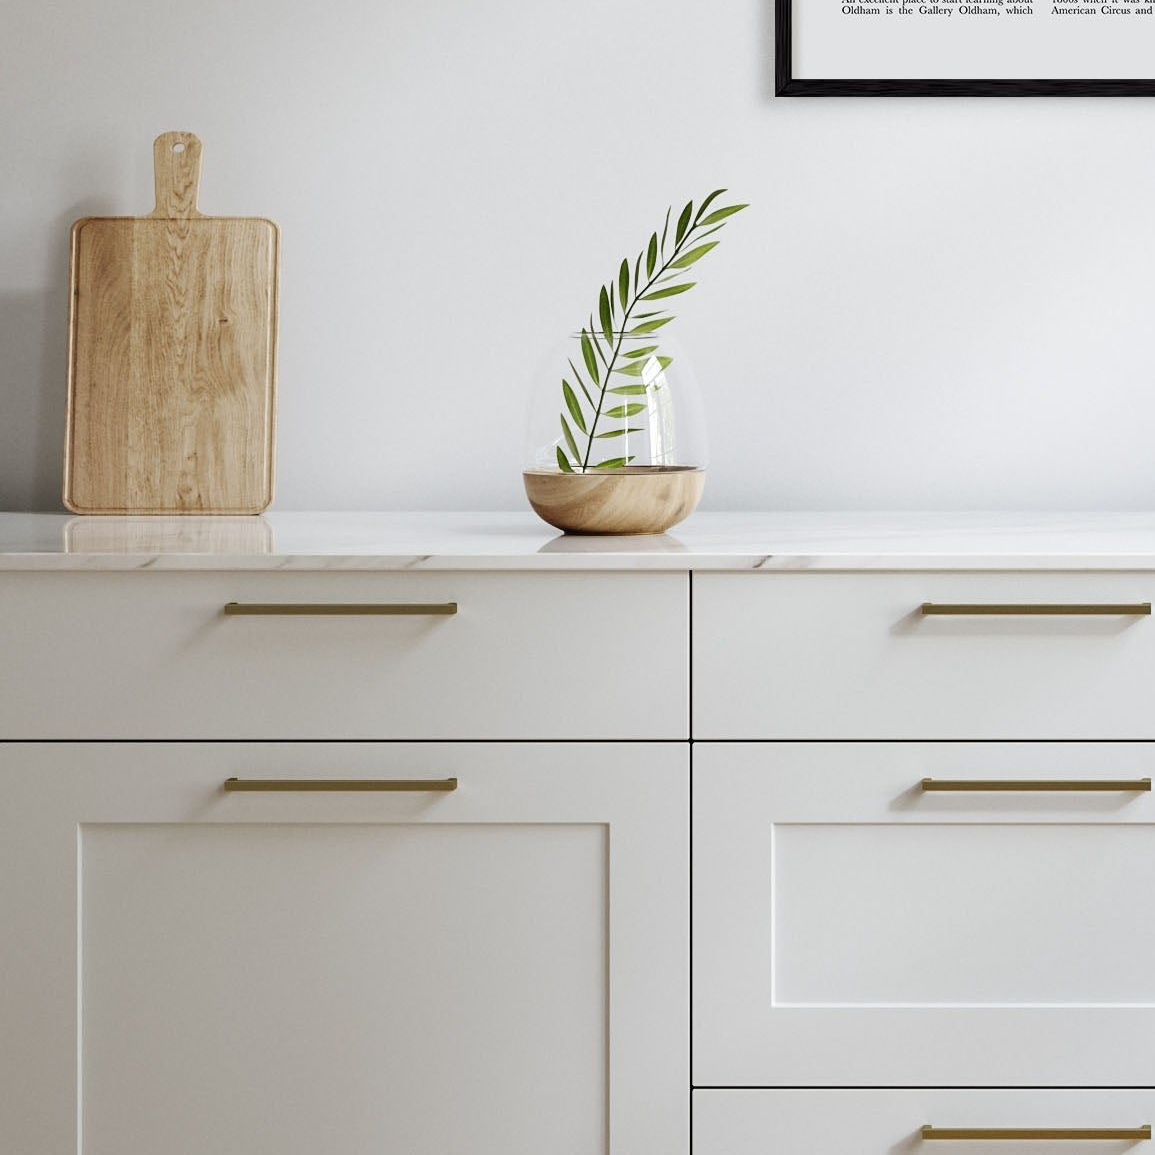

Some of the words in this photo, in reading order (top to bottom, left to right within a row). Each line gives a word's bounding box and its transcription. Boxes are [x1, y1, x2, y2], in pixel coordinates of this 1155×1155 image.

[841, 6, 881, 14] Oldham
[885, 6, 894, 14] is
[898, 6, 914, 14] the
[918, 6, 954, 17] Gallery
[958, 6, 1001, 15] Oldham,
[1005, 6, 1033, 14] which
[1051, 6, 1097, 14] American
[1100, 6, 1131, 14] Circus
[1134, 6, 1153, 14] and
